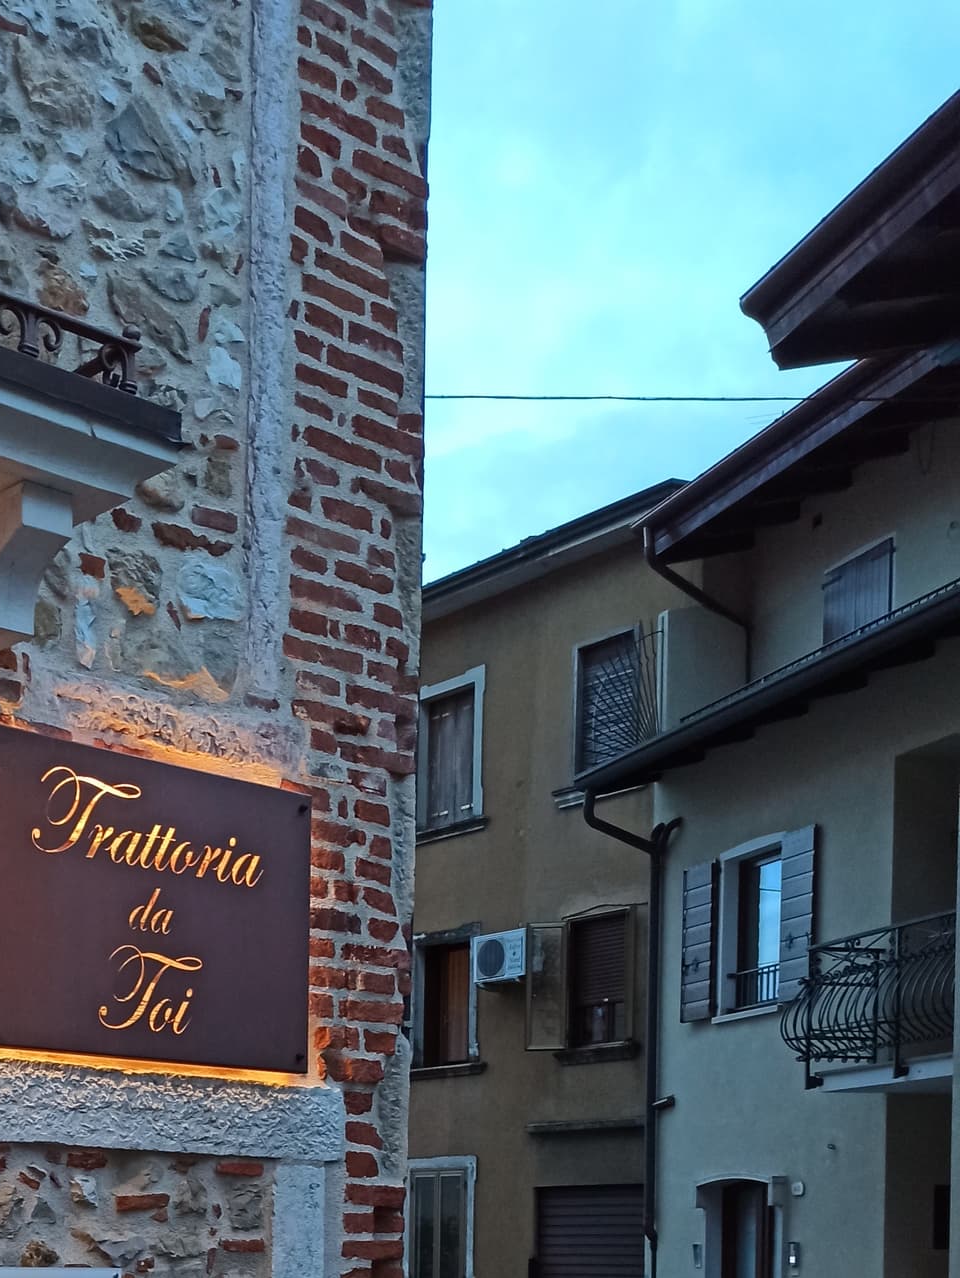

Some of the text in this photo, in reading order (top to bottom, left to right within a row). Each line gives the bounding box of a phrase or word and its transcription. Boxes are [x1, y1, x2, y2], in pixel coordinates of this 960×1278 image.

[31, 766, 264, 887] Trattoria
[128, 888, 174, 935] da
[98, 944, 203, 1034] Toi
